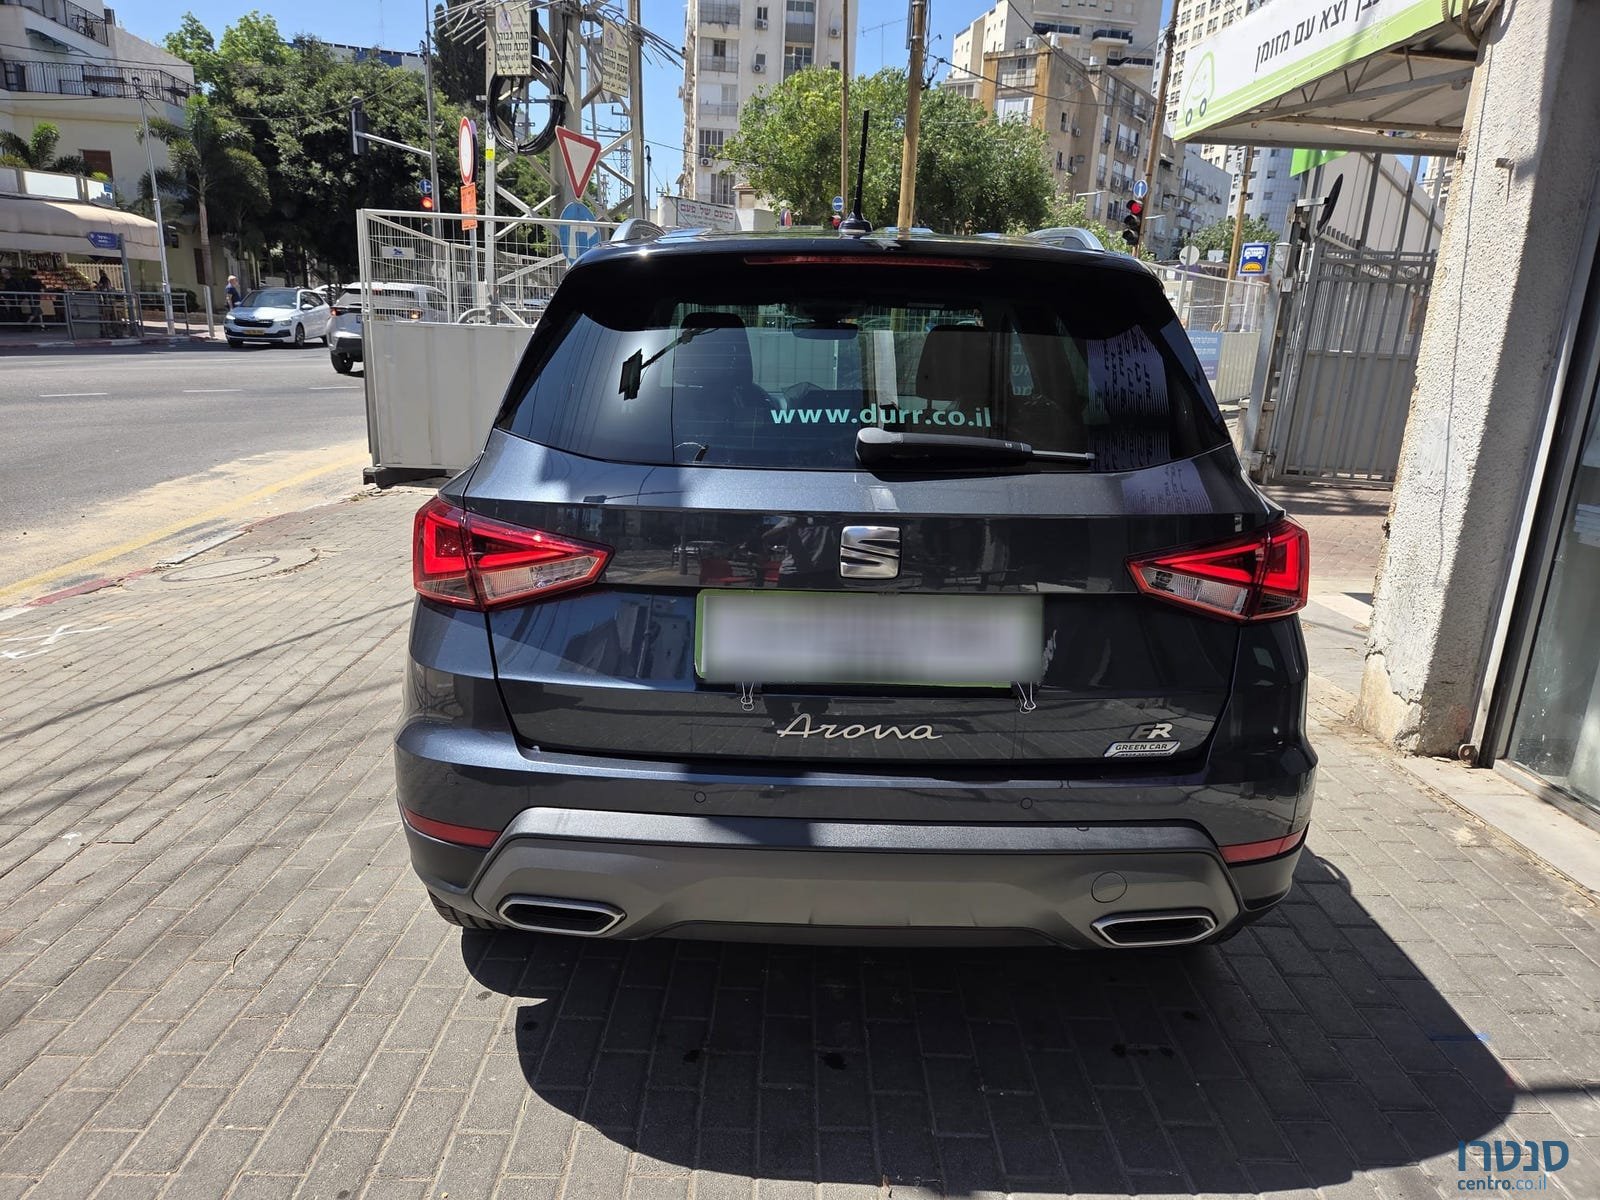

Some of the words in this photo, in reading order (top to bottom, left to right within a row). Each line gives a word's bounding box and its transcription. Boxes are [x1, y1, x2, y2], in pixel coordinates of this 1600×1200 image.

[1293, 16, 1316, 46] עם
[1254, 29, 1291, 73] מזומן
[770, 403, 992, 428] www.durr.co.il
[776, 713, 943, 740] Arona
